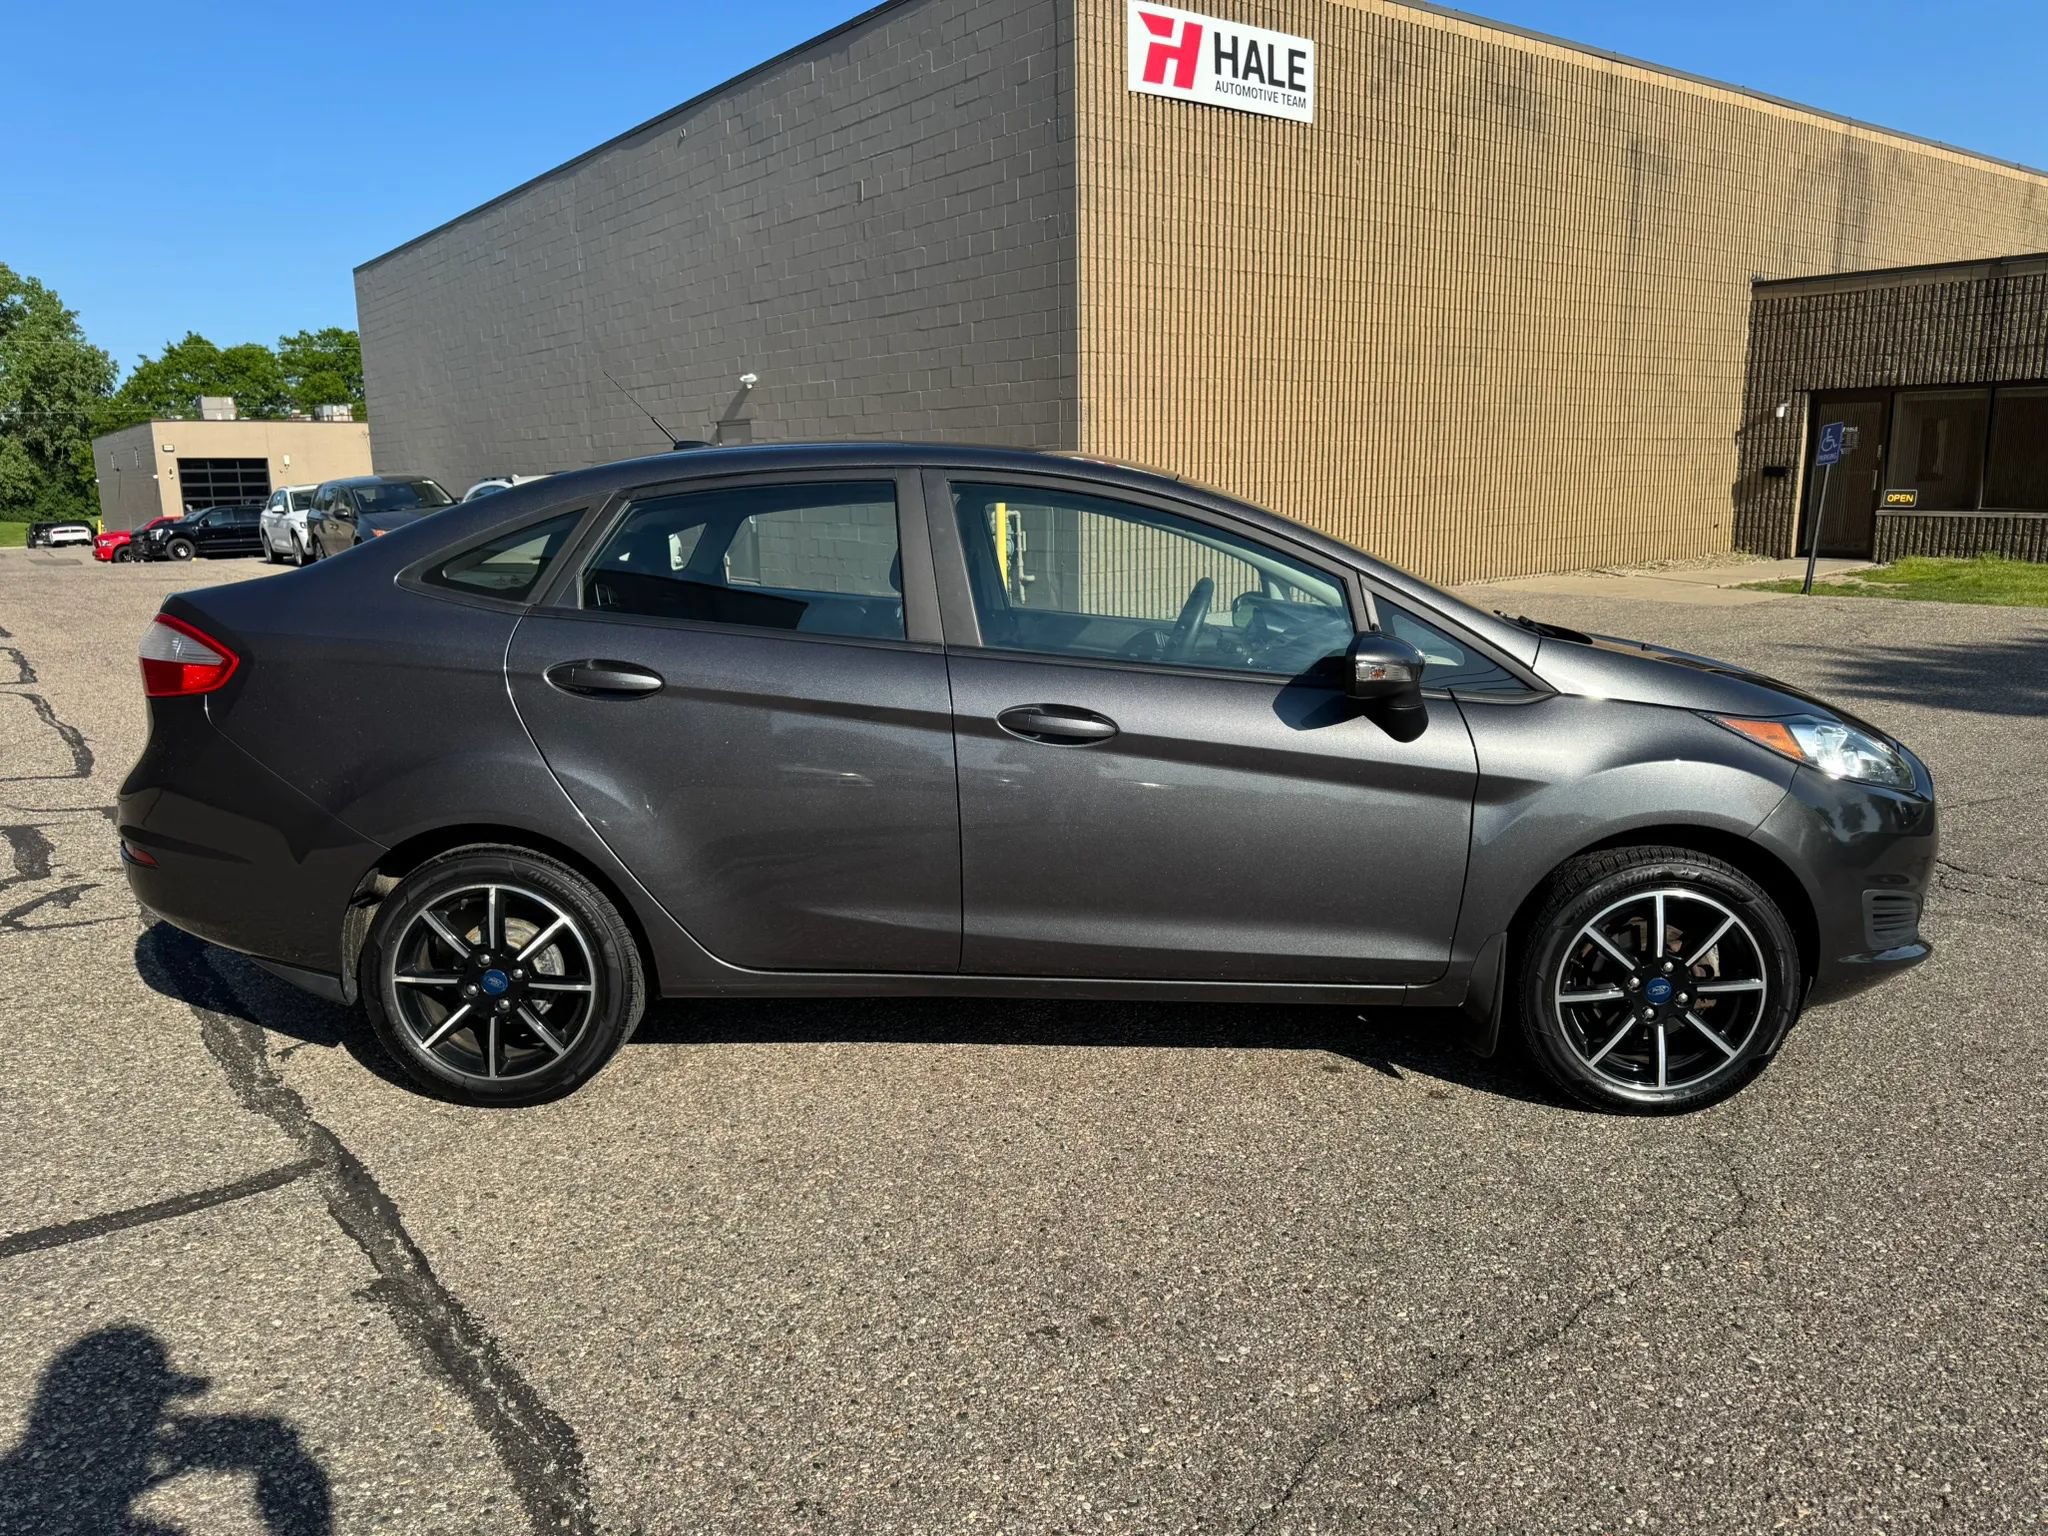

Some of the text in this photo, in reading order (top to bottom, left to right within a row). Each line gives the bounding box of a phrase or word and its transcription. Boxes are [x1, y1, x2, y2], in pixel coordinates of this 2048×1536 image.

[1214, 31, 1307, 93] HALE
[1215, 80, 1307, 109] AUTOMOTIVE TEAM
[1887, 494, 1914, 503] OPEN
